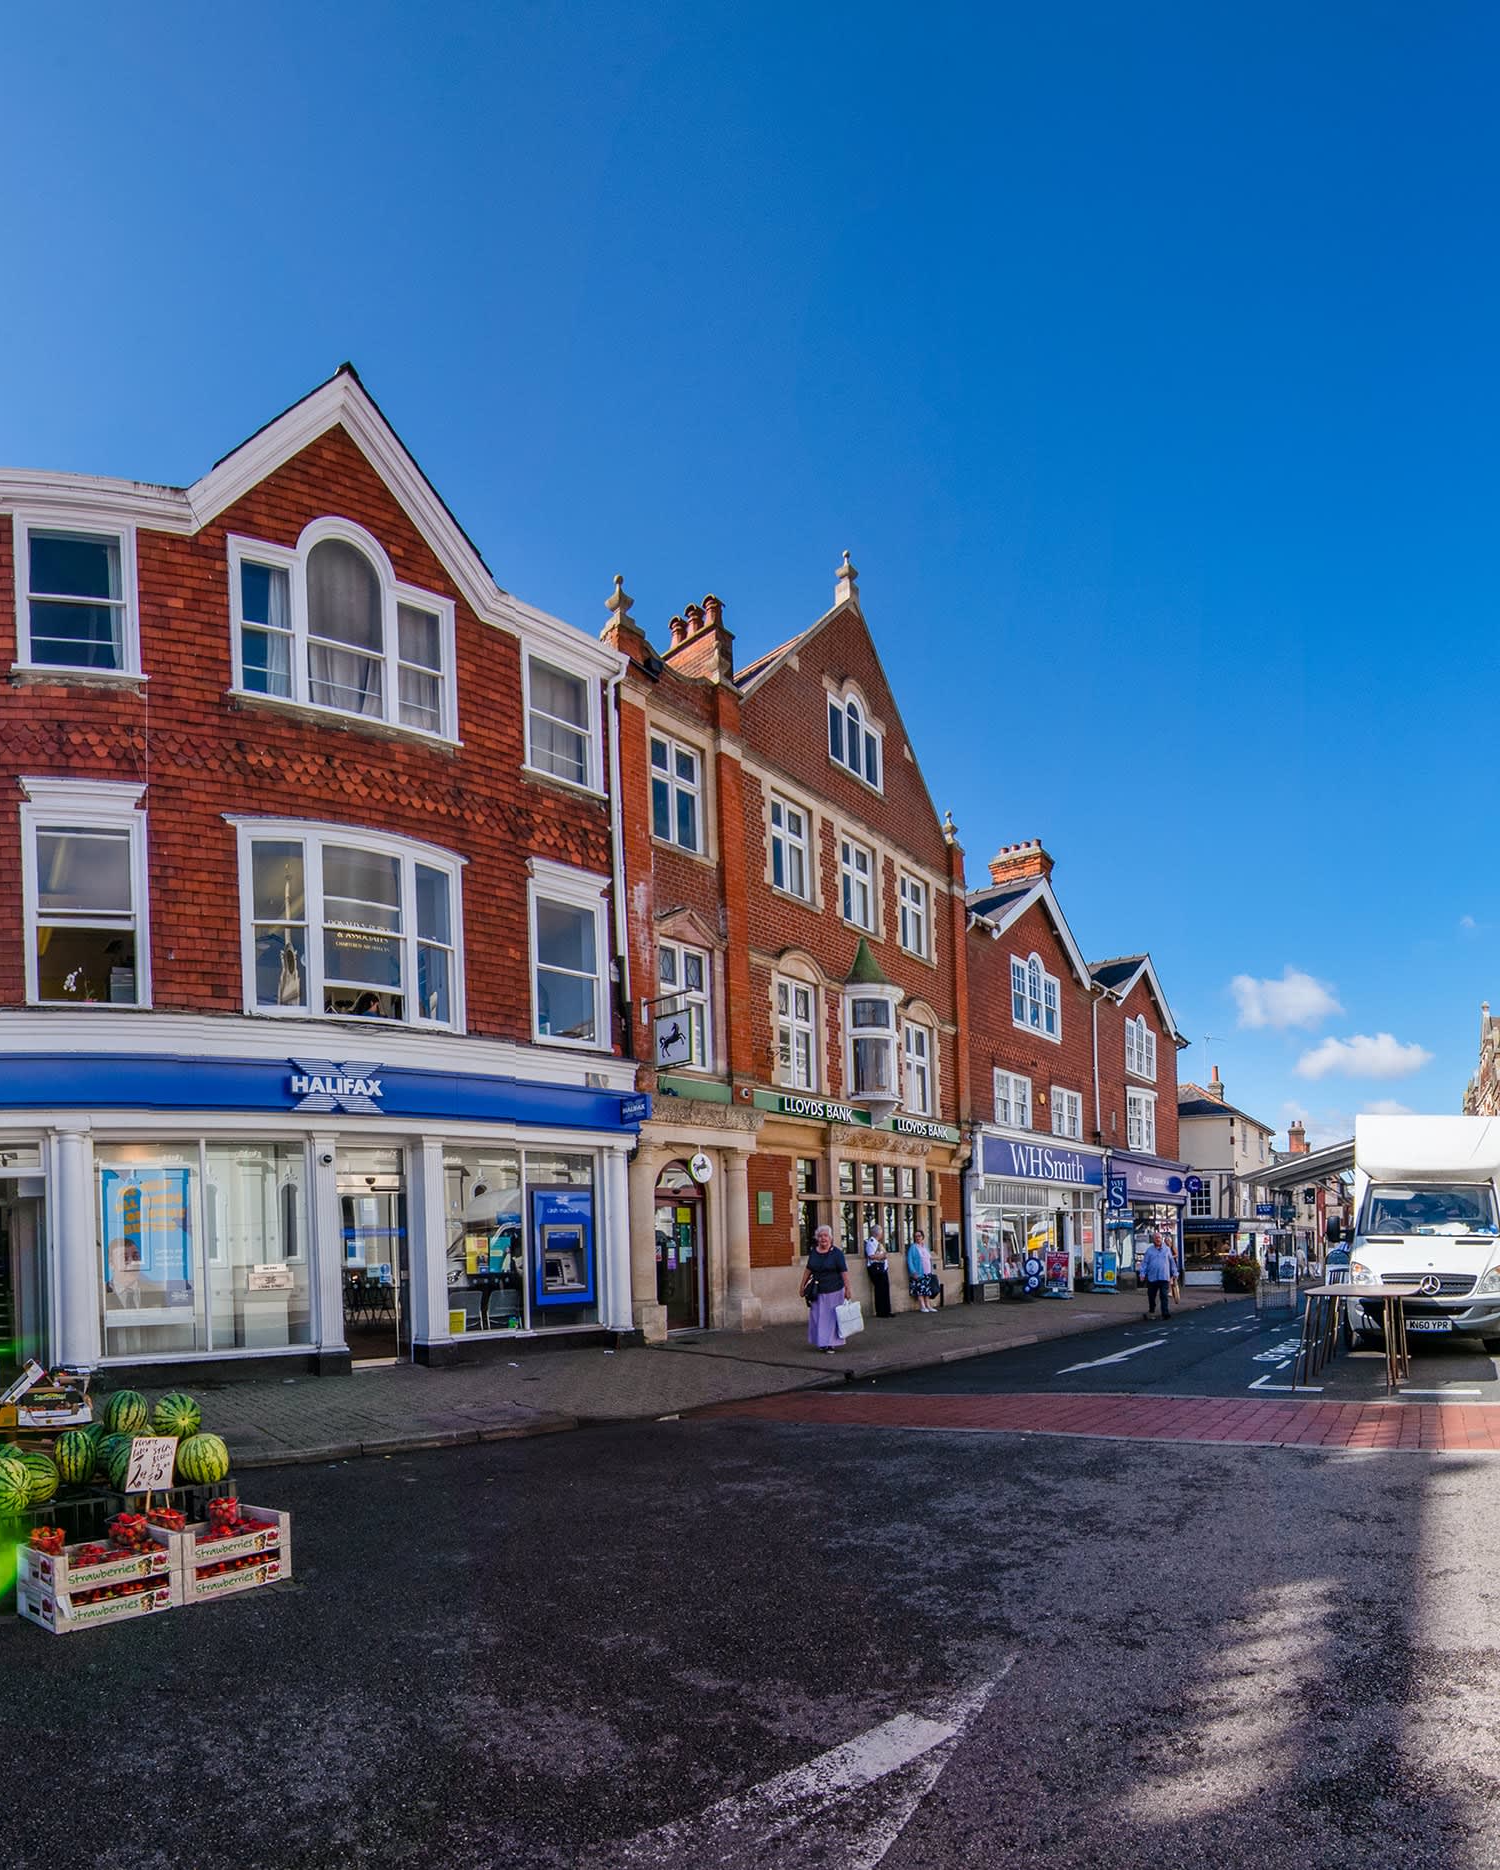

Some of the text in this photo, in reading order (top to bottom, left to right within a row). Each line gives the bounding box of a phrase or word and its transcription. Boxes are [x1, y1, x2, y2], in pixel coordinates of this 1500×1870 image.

[291, 1075, 384, 1097] HALIFAX
[622, 1104, 646, 1114] HALIFAX
[784, 1097, 853, 1122] LLOYDS BANK
[897, 1119, 949, 1140] LLOYDS BANK
[1010, 1143, 1086, 1183] WHSmith
[1111, 1180, 1125, 1188] WH
[1111, 1186, 1124, 1208] S
[1432, 1321, 1449, 1329] YPR
[196, 1539, 254, 1559] Strawberries
[67, 1562, 137, 1585] Strawberries
[196, 1573, 255, 1594] Strawberries
[71, 1600, 140, 1622] Strawberries
